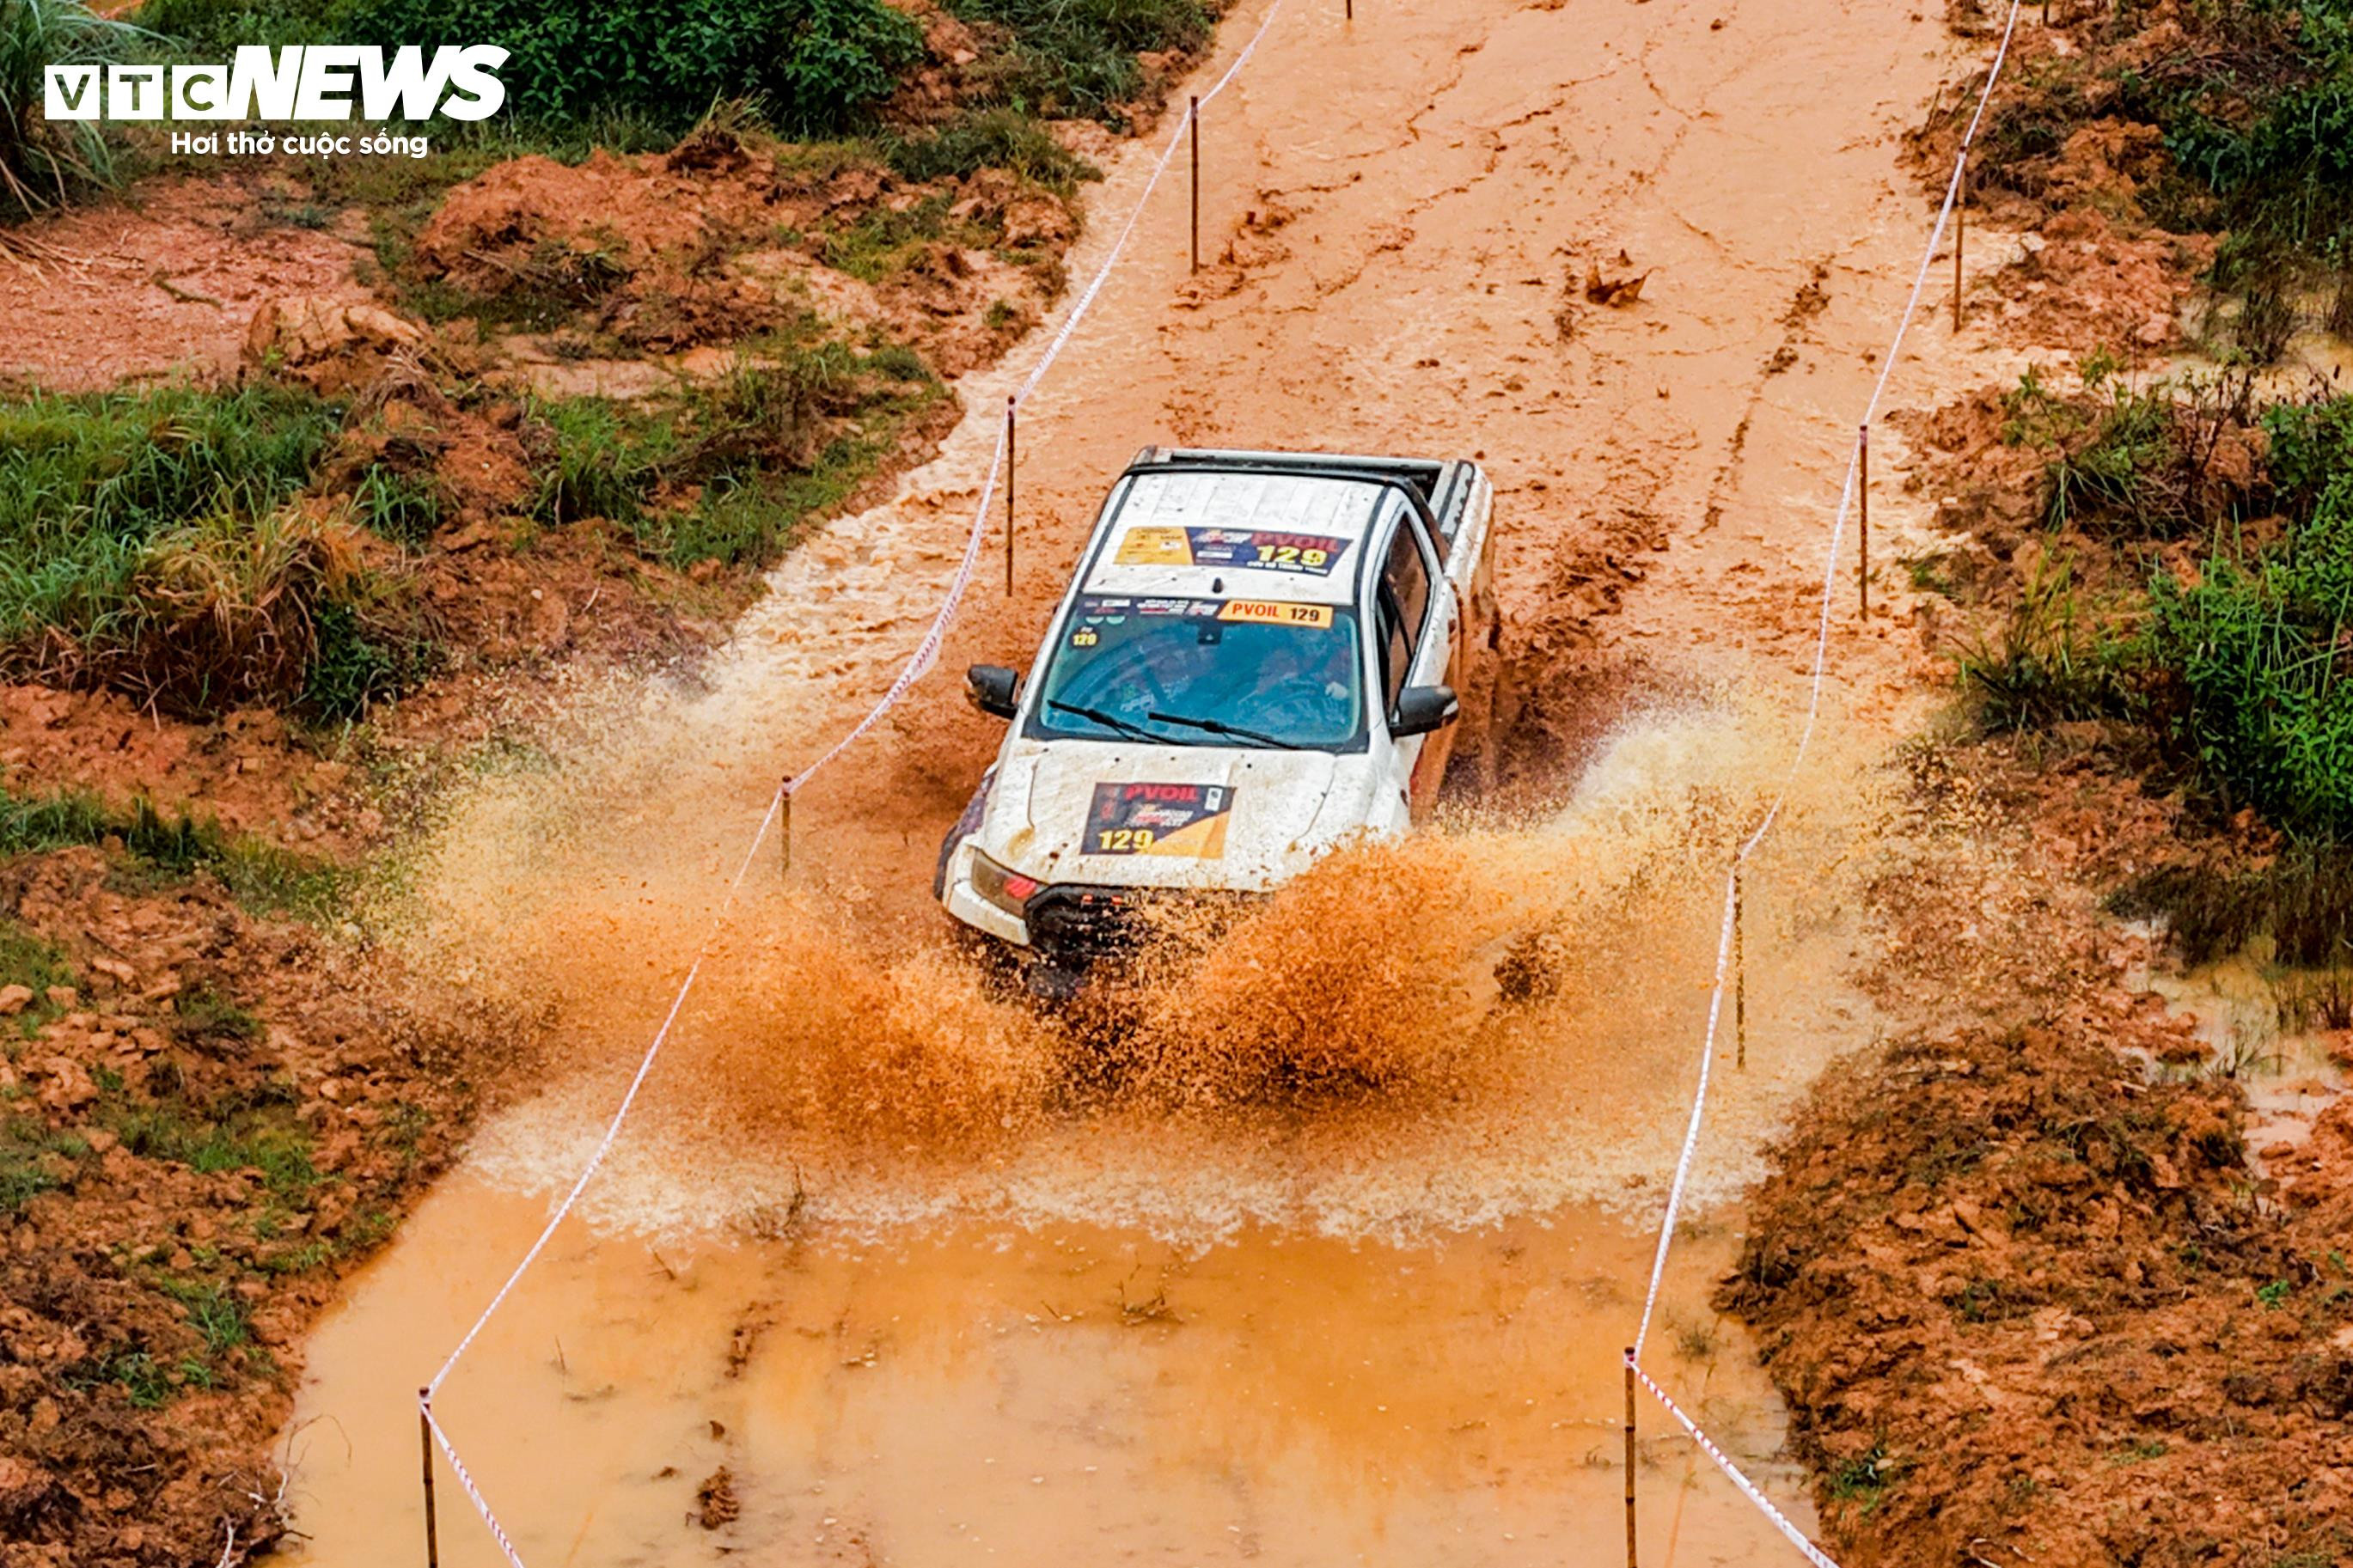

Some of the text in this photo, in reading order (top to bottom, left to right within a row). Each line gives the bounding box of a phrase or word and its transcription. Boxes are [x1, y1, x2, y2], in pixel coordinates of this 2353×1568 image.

[1251, 533, 1337, 552] PVOIL
[1256, 545, 1328, 566] 129
[1232, 603, 1279, 618] PVOIL
[1290, 607, 1320, 622] 129
[1125, 784, 1198, 802] PVOIL
[1099, 829, 1154, 851] 129
